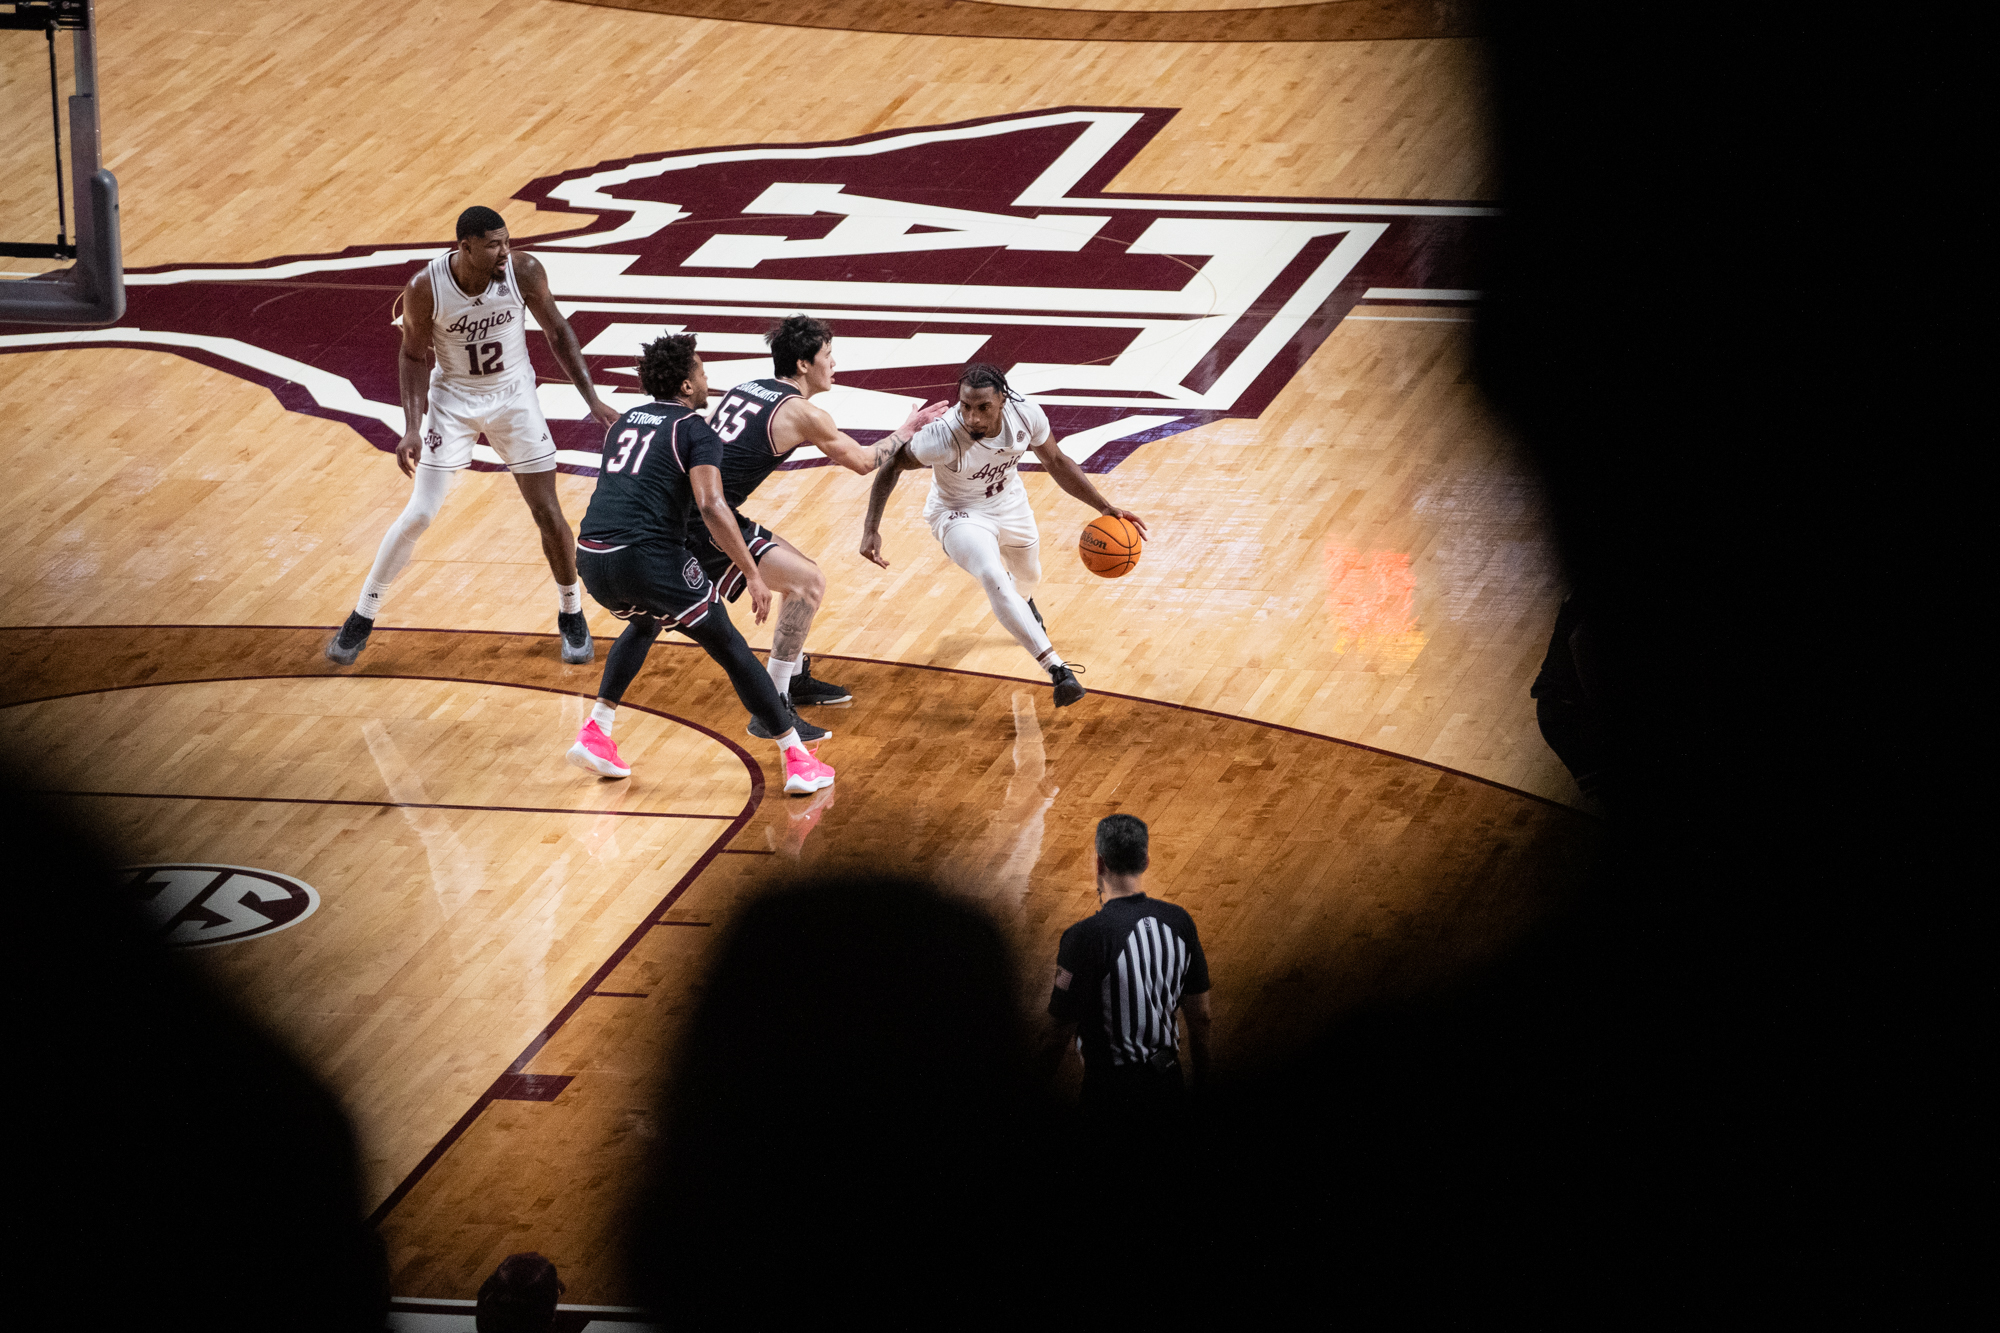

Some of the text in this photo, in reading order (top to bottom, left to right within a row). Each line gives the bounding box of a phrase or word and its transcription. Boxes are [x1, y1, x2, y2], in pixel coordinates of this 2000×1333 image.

[446, 310, 515, 342] Aggies
[465, 341, 505, 376] 12
[626, 411, 667, 426] STRONG
[710, 394, 763, 443] 55
[606, 428, 657, 475] 31
